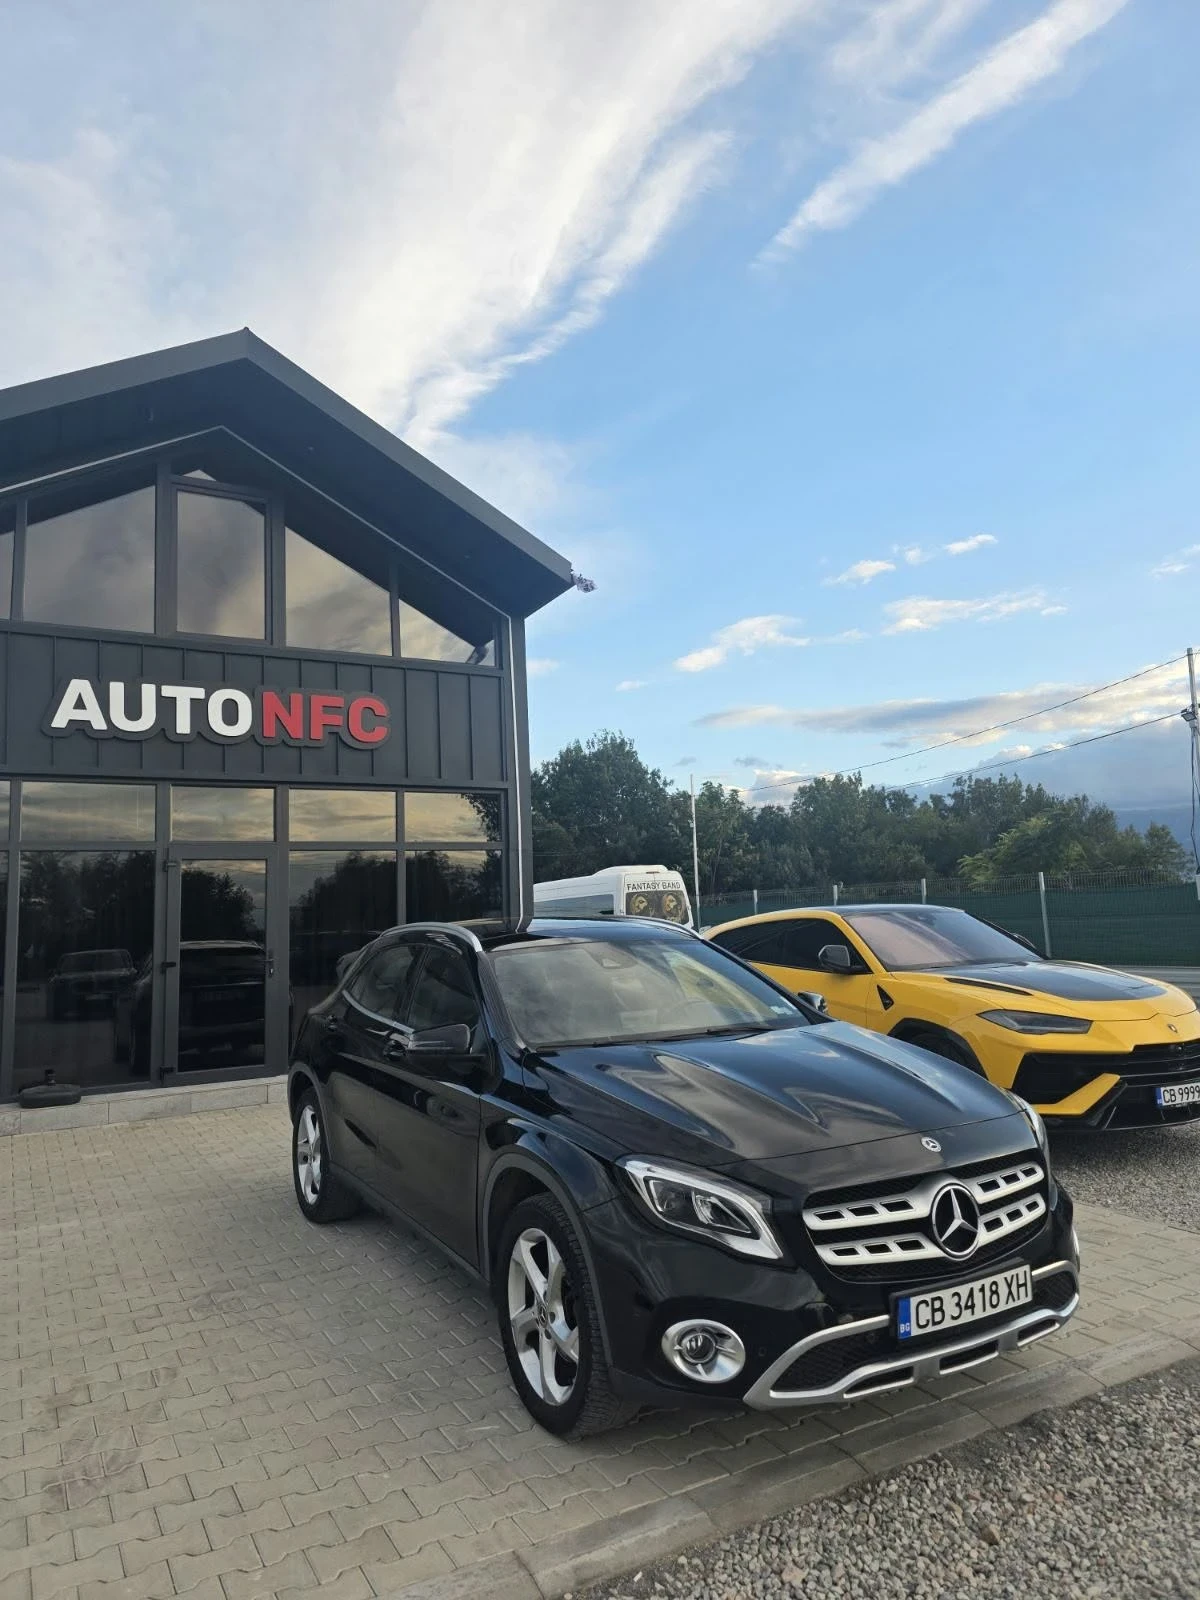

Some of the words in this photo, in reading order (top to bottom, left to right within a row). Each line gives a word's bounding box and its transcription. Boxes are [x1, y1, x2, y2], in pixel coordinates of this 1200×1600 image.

[626, 882, 661, 891] FANTASY
[662, 881, 681, 889] BAND
[1163, 1089, 1176, 1103] CB
[915, 1296, 945, 1329] CB
[950, 1281, 1000, 1321] 3418
[1004, 1270, 1028, 1305] XH
[900, 1322, 910, 1333] BG
